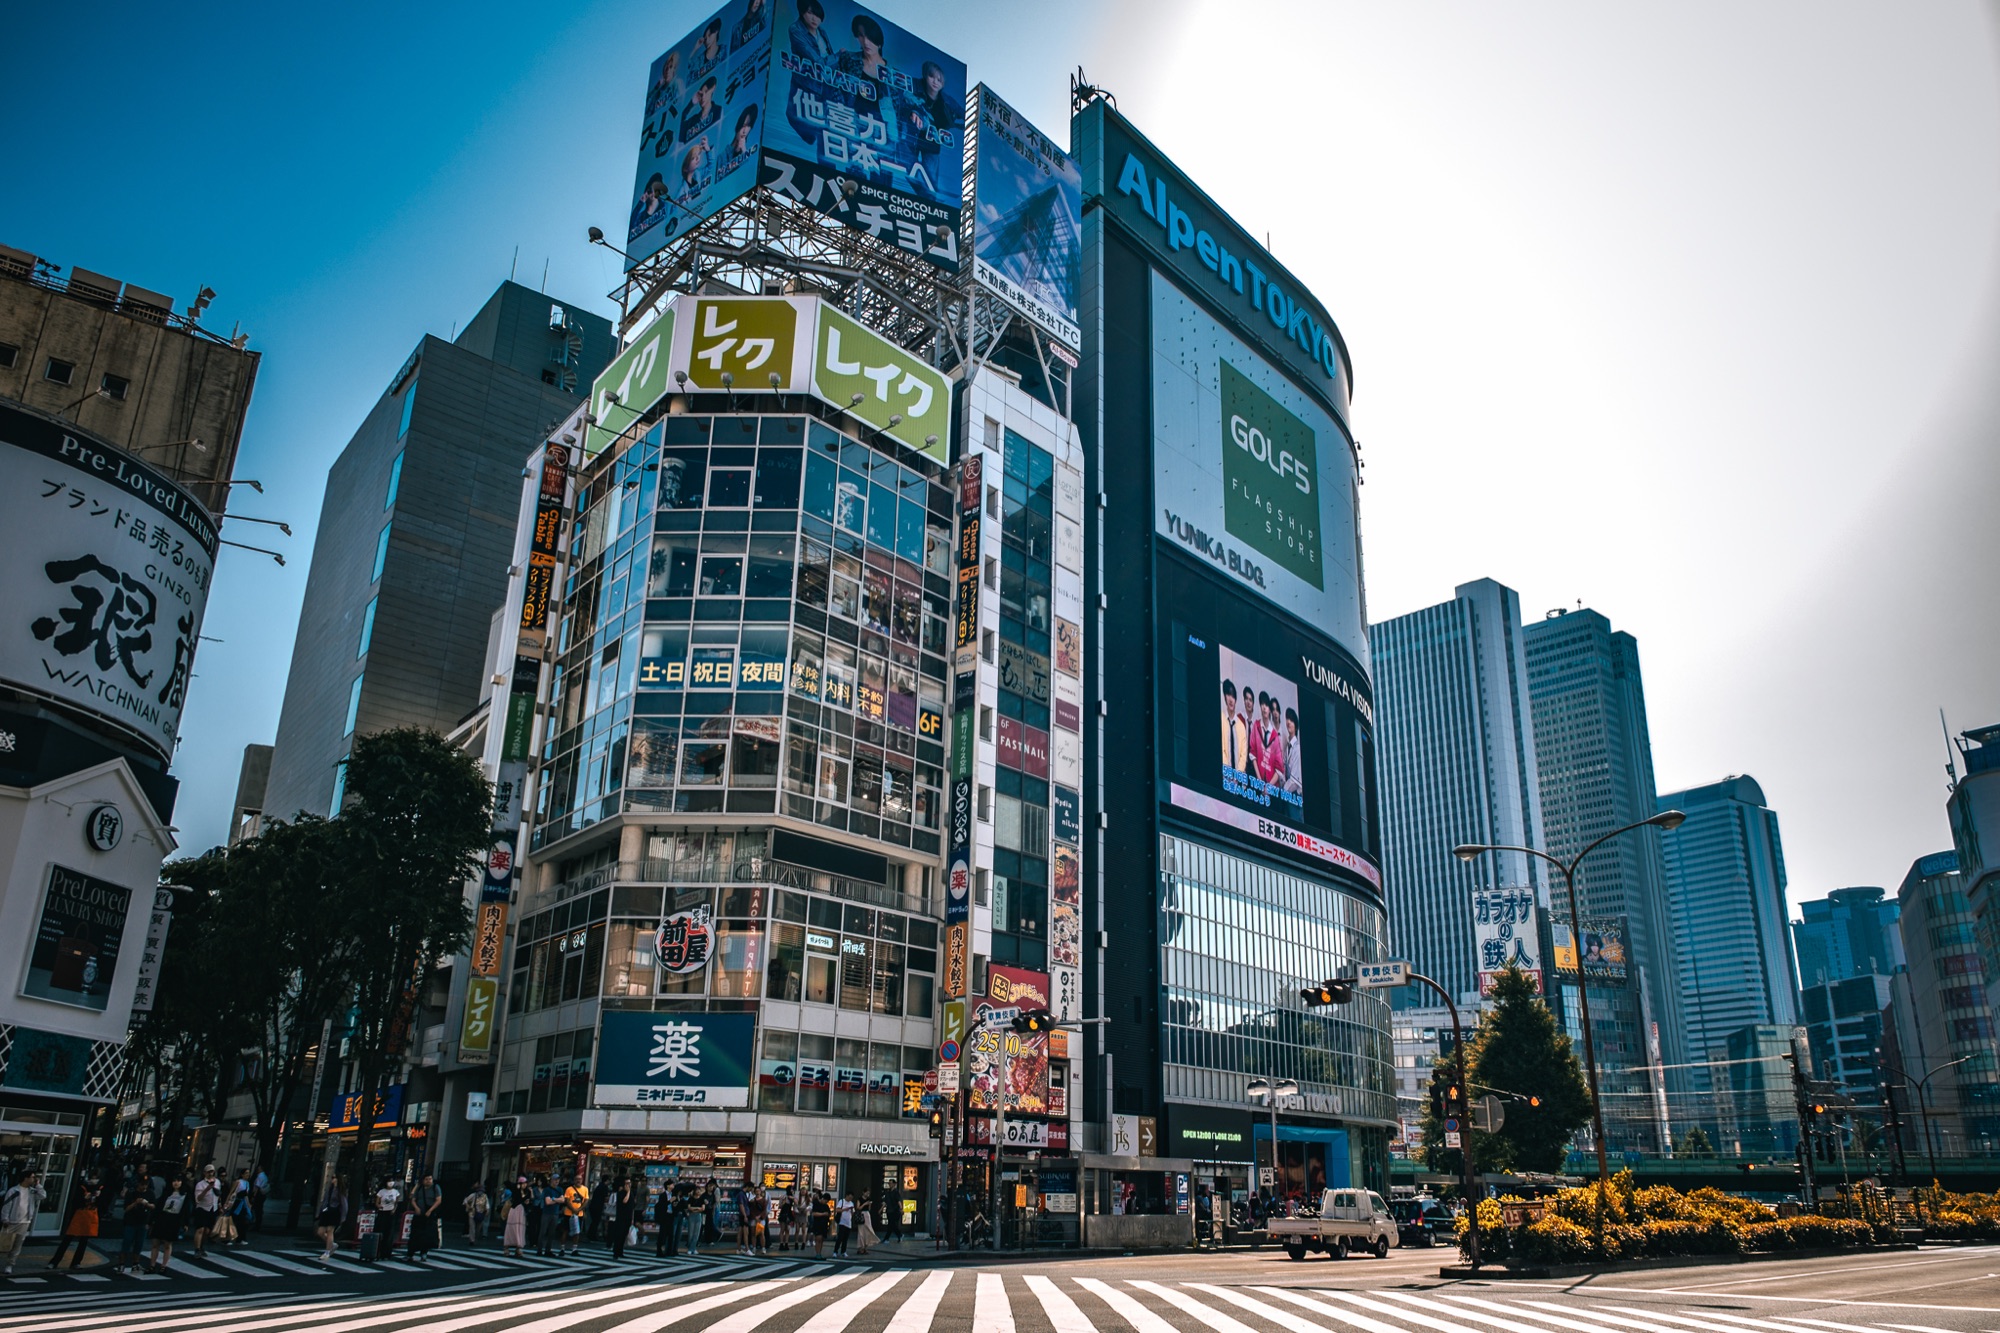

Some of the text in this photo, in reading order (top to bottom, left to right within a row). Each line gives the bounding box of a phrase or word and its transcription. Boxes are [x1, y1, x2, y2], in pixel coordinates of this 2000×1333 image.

[781, 51, 876, 101] MANATO
[876, 64, 913, 93] REI
[792, 88, 887, 146] 他喜力
[822, 129, 936, 193] 日本一へ
[860, 185, 949, 220] SPICE CHOCOLATE
[888, 204, 926, 222] GROUP
[855, 202, 958, 263] チョコ
[1116, 152, 1336, 380] Alpen TOKYO
[977, 263, 1079, 345] 不動産は株式会社TFC
[826, 325, 934, 418] レイク
[58, 434, 177, 512] Pre-Loved
[1230, 414, 1311, 495] GOLF5
[535, 511, 548, 544] Table
[1232, 478, 1315, 543] FLAGSHIP
[544, 509, 559, 550] Cheese
[962, 526, 971, 559] Table
[969, 519, 979, 561] Cheese
[1264, 520, 1315, 563] STORE
[531, 552, 545, 563] 7F
[1164, 509, 1268, 591] YUNIKA BLDG.
[144, 564, 192, 606] GINZO
[968, 567, 978, 577] 7F
[693, 661, 733, 684] 祝日
[741, 661, 784, 684] 夜間
[792, 662, 819, 682] 保険
[41, 658, 160, 725] WATCHNIAN
[826, 679, 851, 704] 内科
[857, 698, 882, 717] 不要
[858, 685, 884, 704] 予約
[1302, 656, 1374, 727] YUNIKA VISION
[919, 711, 940, 735] 6F
[1000, 718, 1009, 730] 6F
[1000, 734, 1046, 761] FASTNAIL
[954, 781, 969, 843] もつなべ
[1055, 796, 1072, 809] Rydia
[1257, 819, 1357, 869] 日本最大の韓流ニュースサイト
[51, 869, 131, 914] PreLoved
[951, 869, 967, 890] 薬
[46, 894, 126, 931] LUXURY SHOP
[1474, 888, 1533, 925] カラオケ
[479, 905, 501, 972] 肉汁水餃子
[660, 916, 708, 971] 前田屋
[1498, 921, 1514, 940] の
[949, 926, 965, 996] 肉汁水餃子
[1360, 964, 1402, 978] 歌舞伎町
[1480, 937, 1534, 970] 鉄人
[1368, 976, 1395, 985] Kabukicho
[468, 987, 489, 1037] レイク
[947, 1011, 961, 1041] レイ
[645, 1021, 704, 1079] 薬
[1304, 1094, 1343, 1114] TOKYO
[860, 1143, 911, 1155] PANDORA
